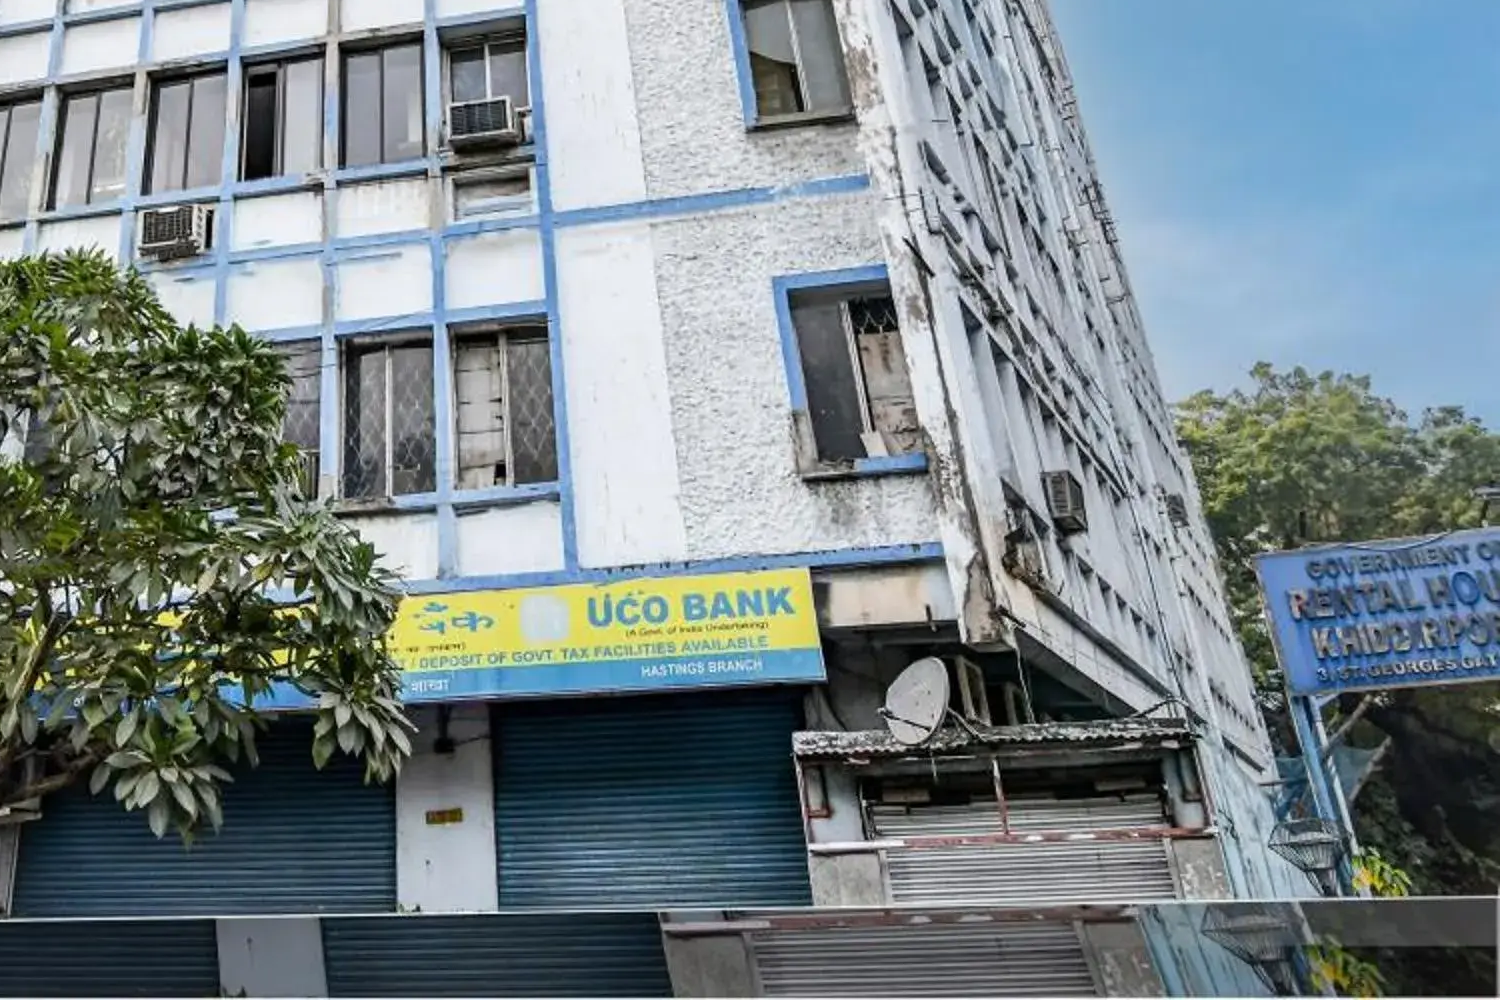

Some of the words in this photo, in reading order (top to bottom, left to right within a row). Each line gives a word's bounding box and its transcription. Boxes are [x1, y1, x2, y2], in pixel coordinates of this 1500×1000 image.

[1306, 544, 1471, 580] GOVERNMENT
[586, 591, 669, 629] UCO
[682, 584, 796, 622] BANK
[1286, 577, 1426, 621] RENTAL
[419, 652, 483, 670] DEPOSIT
[487, 651, 507, 665] OF
[560, 646, 589, 661] TAX
[593, 641, 677, 658] FACILITIES
[680, 635, 769, 653] AVAILABLE
[641, 661, 705, 678] HASTINGS
[708, 658, 764, 674] BRANCH
[1367, 659, 1458, 678] GEORGES
